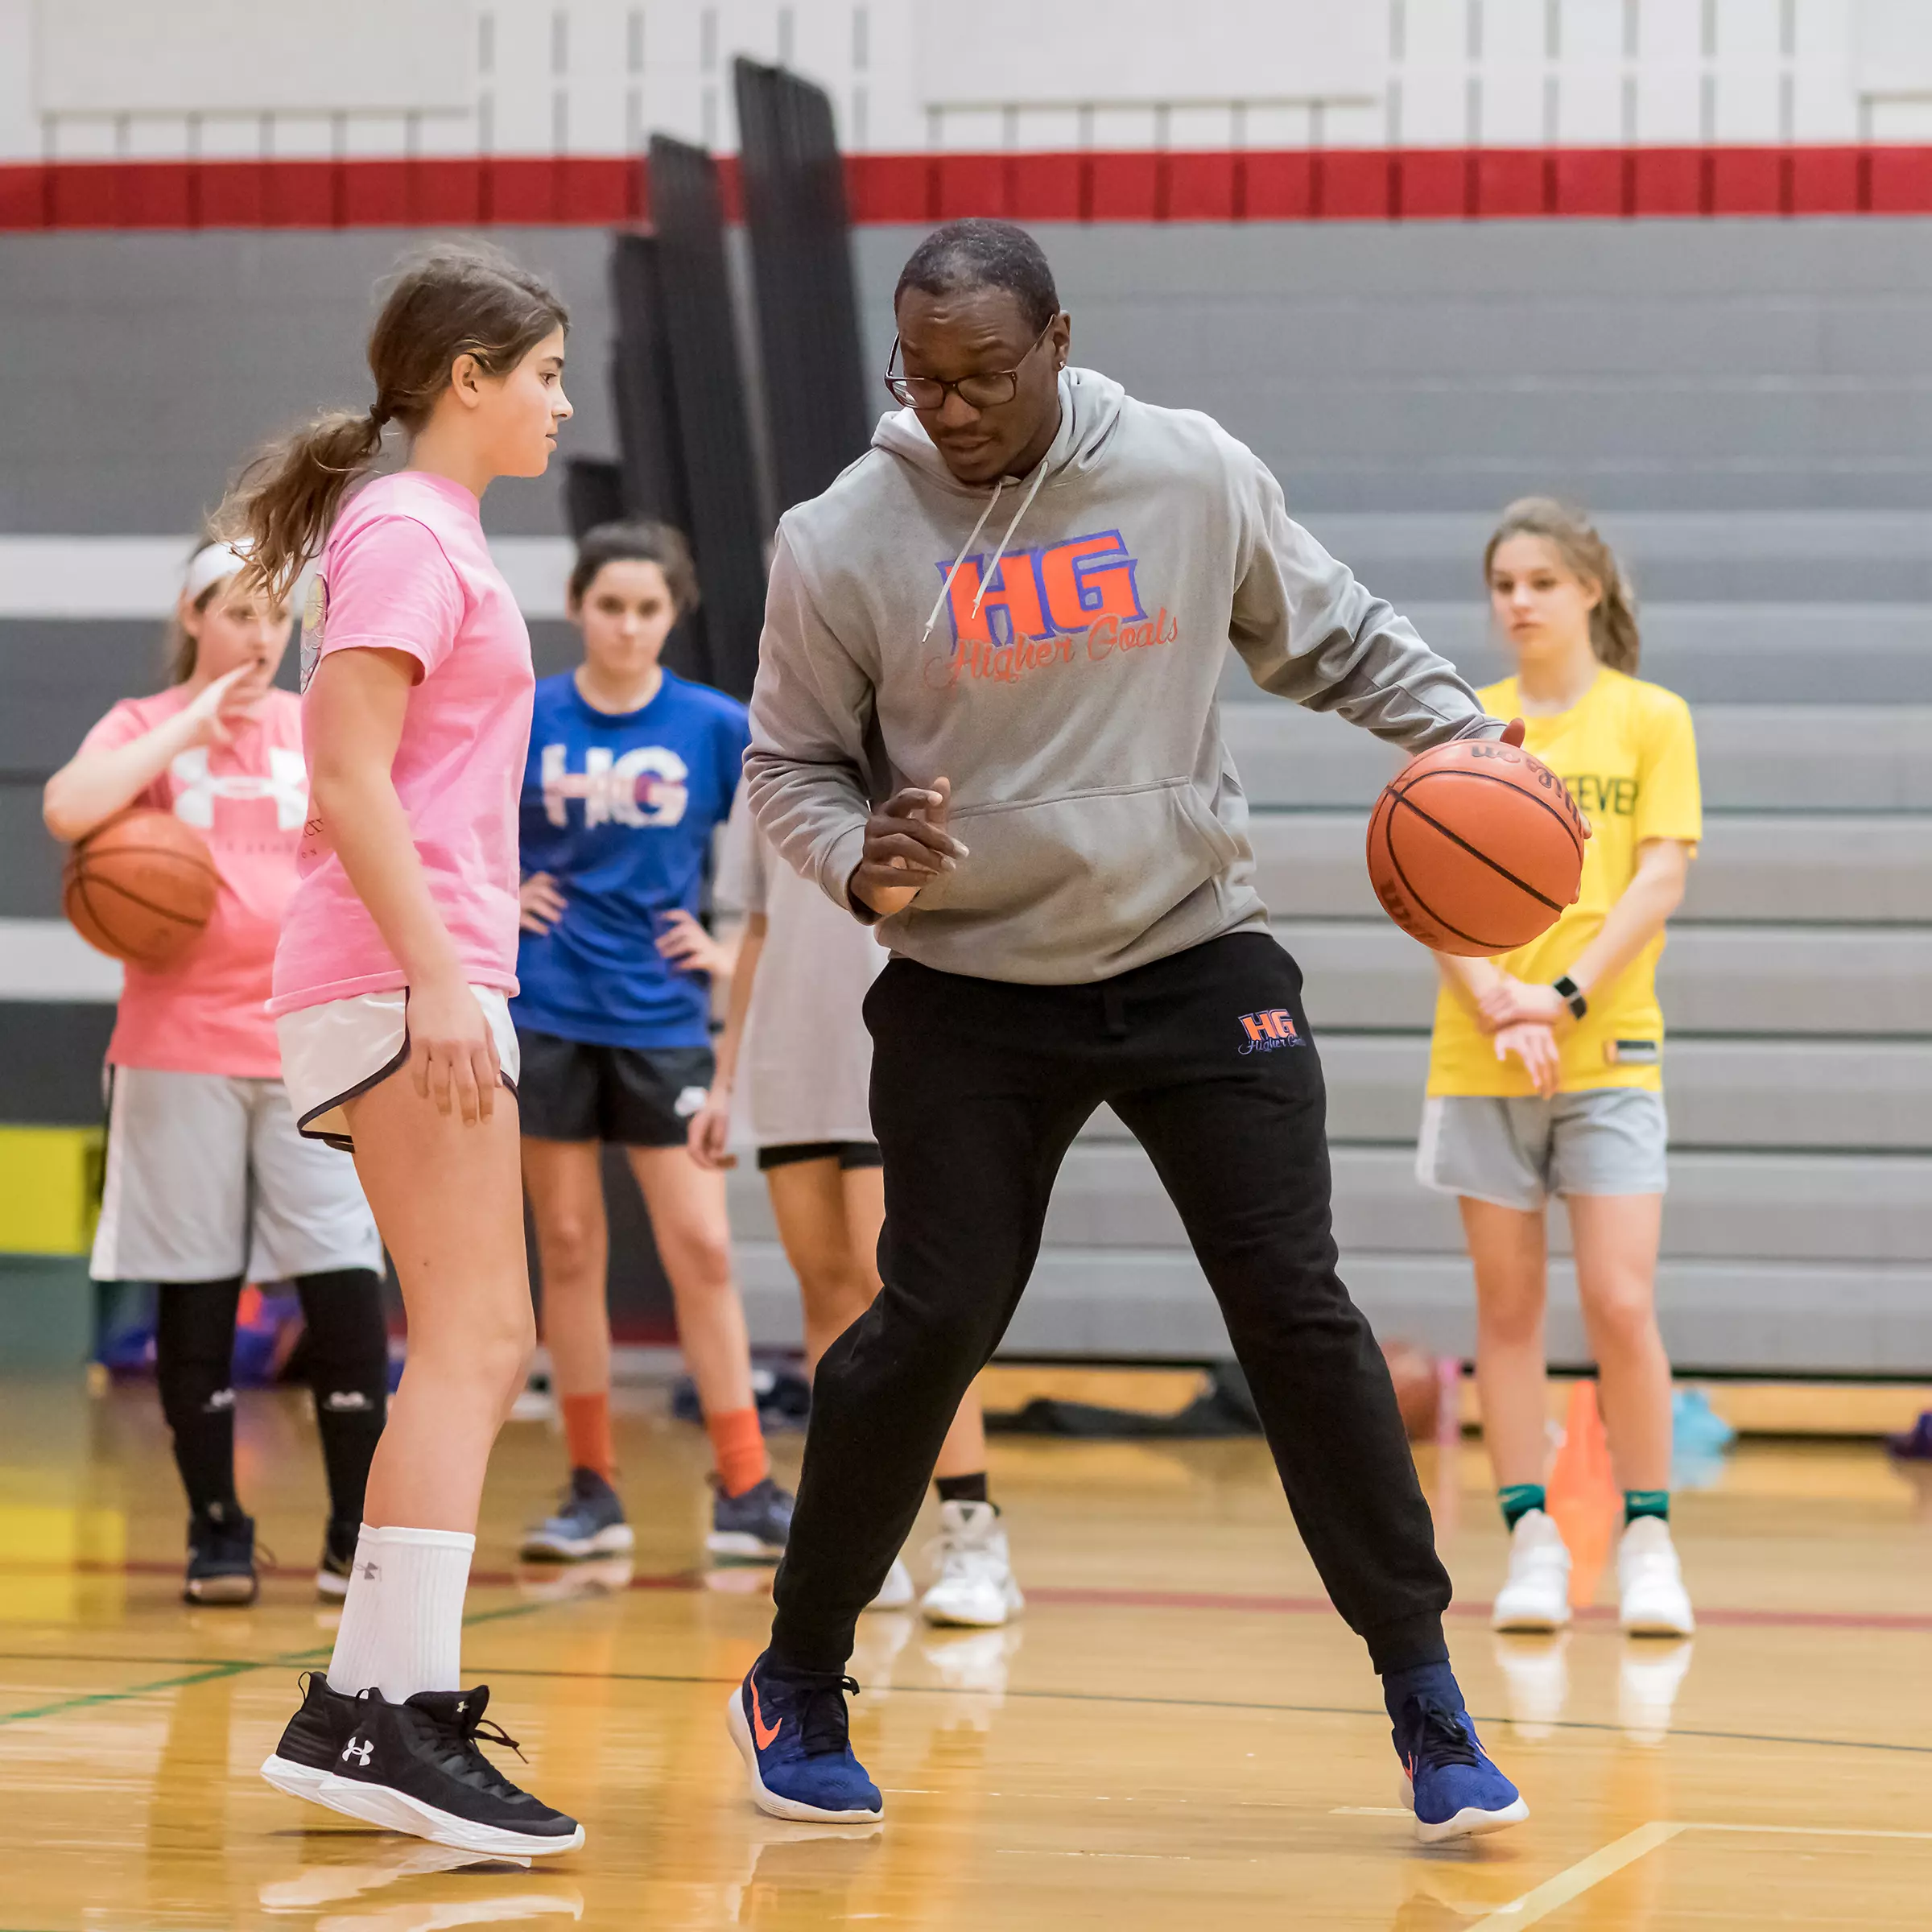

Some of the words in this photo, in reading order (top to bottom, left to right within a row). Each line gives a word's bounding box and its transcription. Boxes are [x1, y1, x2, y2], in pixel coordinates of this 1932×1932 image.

[935, 529, 1149, 656] HG
[923, 632, 1075, 691] Higher
[1088, 606, 1179, 662] Goals
[541, 743, 688, 829] HG
[1237, 1009, 1298, 1042] HG
[1238, 1037, 1287, 1055] Higher
